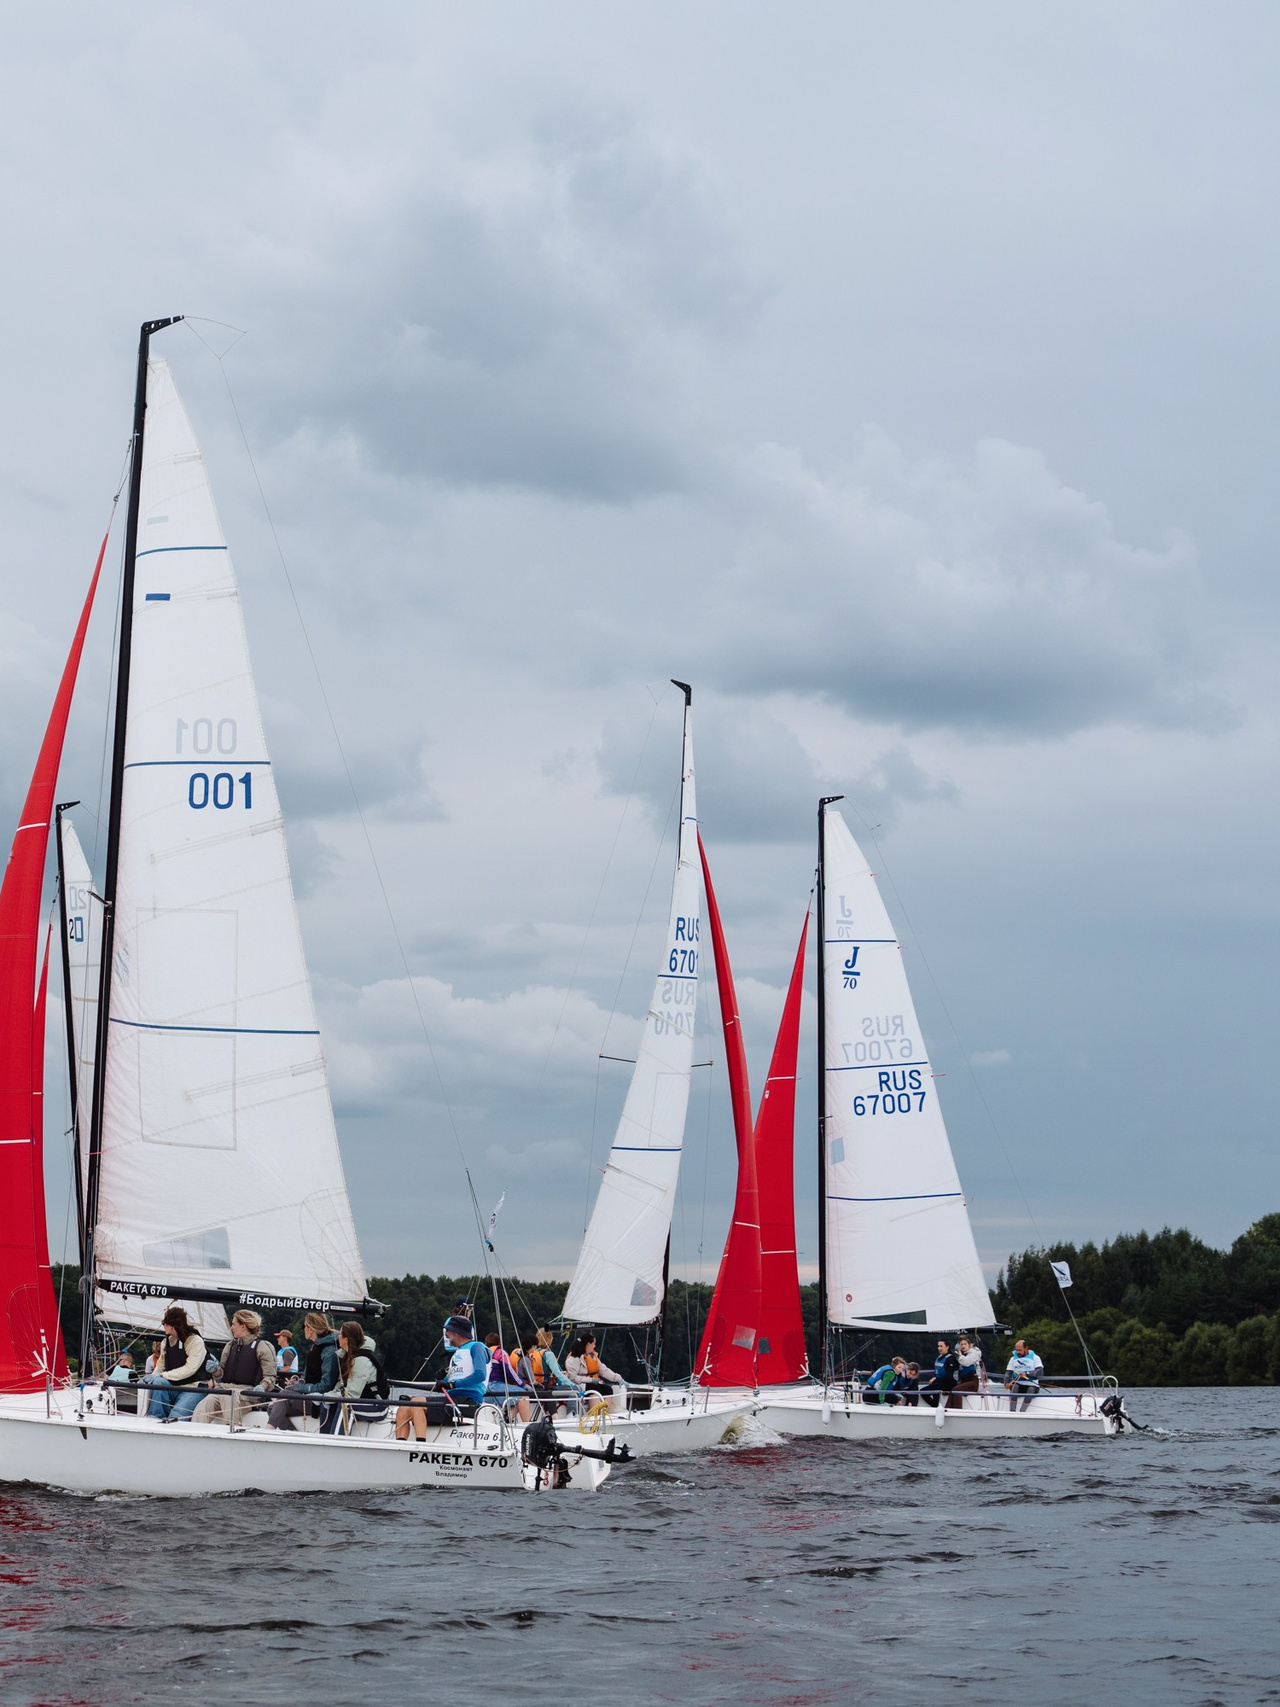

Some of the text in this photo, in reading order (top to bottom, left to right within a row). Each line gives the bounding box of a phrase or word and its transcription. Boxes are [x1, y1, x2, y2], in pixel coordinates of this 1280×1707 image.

[189, 772, 251, 809] 001
[69, 917, 84, 942] 20
[675, 917, 699, 942] RUS
[844, 946, 860, 969] J
[842, 977, 857, 989] 70
[878, 1069, 922, 1092] RUS
[853, 1091, 926, 1116] 67007
[110, 1281, 167, 1296] РАКЕТА 670
[239, 1293, 329, 1312] #БодрыйВетер
[492, 1432, 510, 1442] 60
[409, 1452, 507, 1468] РАКЕТА 670
